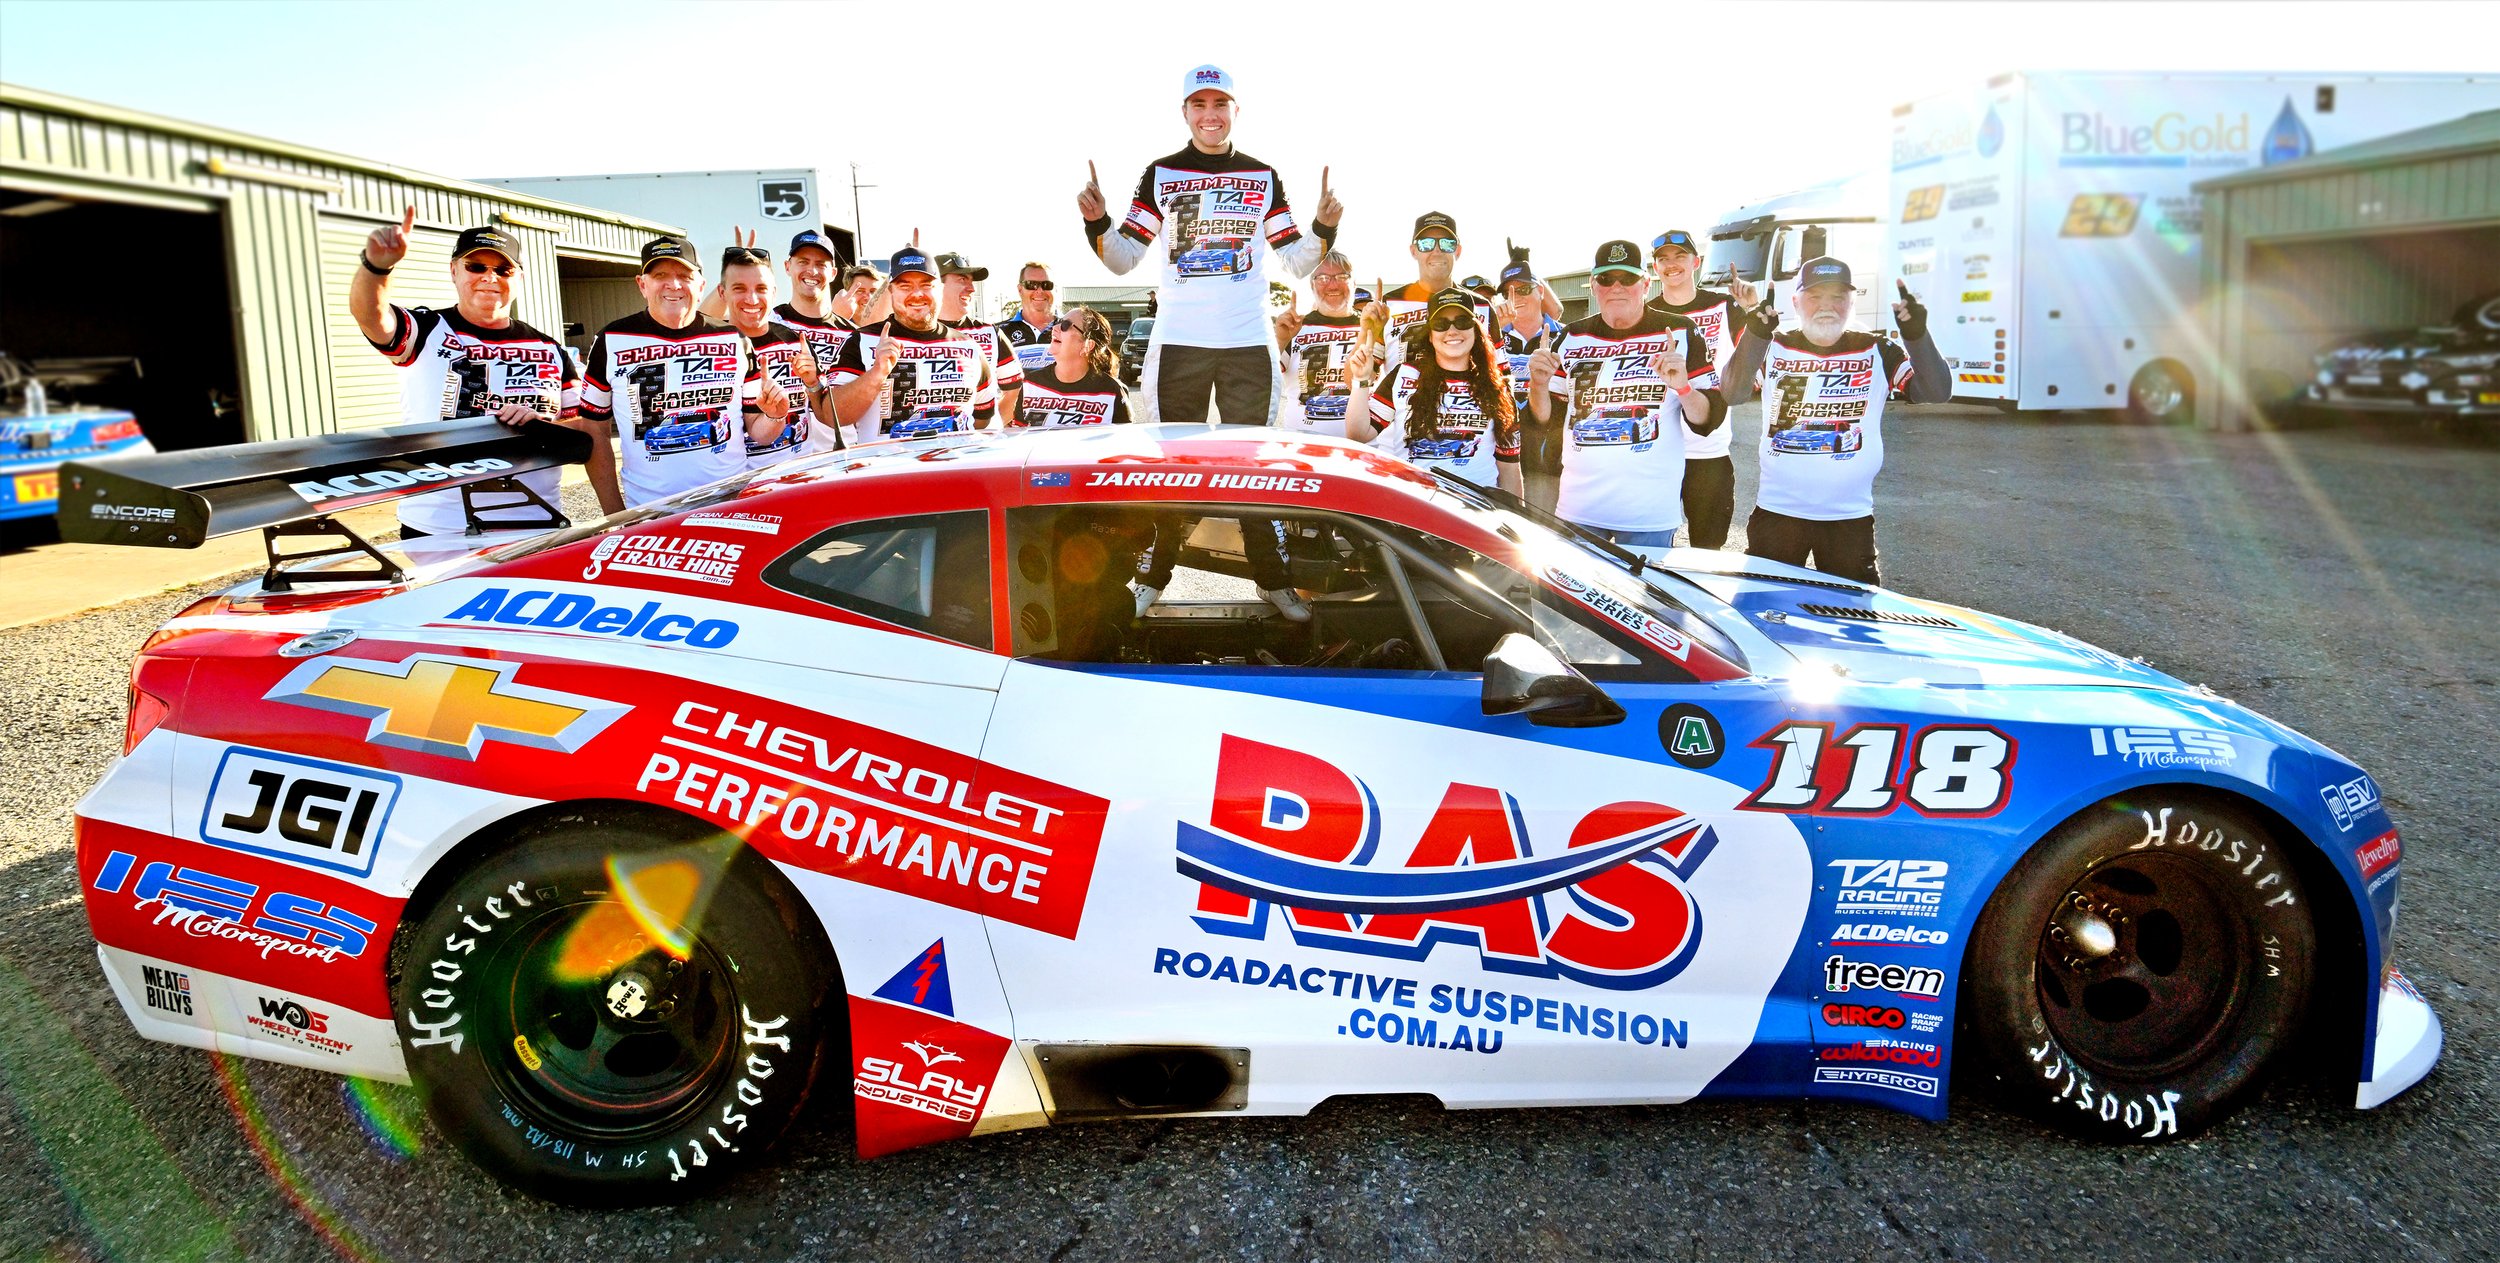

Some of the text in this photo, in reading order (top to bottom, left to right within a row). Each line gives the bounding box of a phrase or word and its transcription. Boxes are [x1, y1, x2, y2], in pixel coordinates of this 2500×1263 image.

[1160, 177, 1268, 196] CHAMPION
[1209, 191, 1265, 207] TA2
[1213, 205, 1261, 214] RACING
[1186, 226, 1256, 238] HUGHES
[1189, 219, 1257, 229] JARROD
[1296, 331, 1360, 345] CHAMP
[614, 343, 737, 366] CHAMPION
[674, 357, 738, 373] TA2
[1772, 355, 1875, 372] CHAMPION
[496, 361, 562, 381] TA2
[681, 372, 736, 383] RACING
[1817, 370, 1873, 387] TA2
[654, 387, 734, 401] JARROD
[1583, 393, 1666, 405] HUGHES
[1587, 384, 1667, 396] JARROD
[1819, 386, 1870, 395] RACING
[651, 396, 733, 412] HUGHES
[1022, 396, 1109, 416] CHAMPION
[1787, 408, 1866, 418] HUGHES
[1790, 400, 1868, 411] JARROD
[1054, 411, 1103, 425] TA2
[1436, 413, 1489, 421] ARROD
[289, 457, 514, 503] ACDelco
[1085, 472, 1323, 493] JARROD HUGHES
[91, 504, 176, 519] ENCORE
[733, 513, 783, 524] BELLOTTI
[620, 535, 746, 563] COLLIERS
[613, 550, 740, 578] CRANE HIRE
[699, 576, 731, 585] .com.au
[1583, 592, 1644, 631] SERIES
[1588, 587, 1645, 621] SUPER
[443, 587, 740, 649] ACDelco
[1671, 715, 1717, 756] A
[672, 700, 1064, 835] CHEVROLET
[1734, 719, 2019, 819] 118
[2124, 748, 2233, 772] Motorsport
[221, 769, 380, 856] JGI
[636, 752, 1049, 905] PERFORMANCE
[1178, 733, 1720, 991] RAS
[2356, 836, 2399, 872] Llewellyn
[1827, 859, 1949, 889] TA2
[1837, 890, 1942, 904] RACING
[134, 897, 359, 963] Motorsport
[1830, 924, 1949, 945] ACDelco
[409, 880, 532, 1055] Hoosier
[1153, 947, 1417, 1009] ROADACTIVE
[1824, 955, 1945, 997] freem
[142, 965, 180, 992] MEAT
[147, 987, 193, 1016] BILLYS
[1428, 983, 1690, 1050] SUSPENSION
[1821, 1003, 1905, 1030] CIRCO
[1911, 1018, 1940, 1028] BRAKE
[1912, 1012, 1944, 1022] RACING
[247, 1014, 353, 1051] WHEELY SHINY
[1338, 1007, 1503, 1055] .COM.AU
[1911, 1025, 1935, 1033] PADS
[260, 1028, 342, 1055] TIME TO SHINE
[1881, 1040, 1936, 1052] RACING
[858, 1056, 986, 1106] SLAY
[1839, 1071, 1933, 1092] HYPERCO
[2029, 1041, 2181, 1139] Hoosier
[667, 1003, 791, 1182] Hoosier
[854, 1082, 973, 1120] INDUSTRIES
